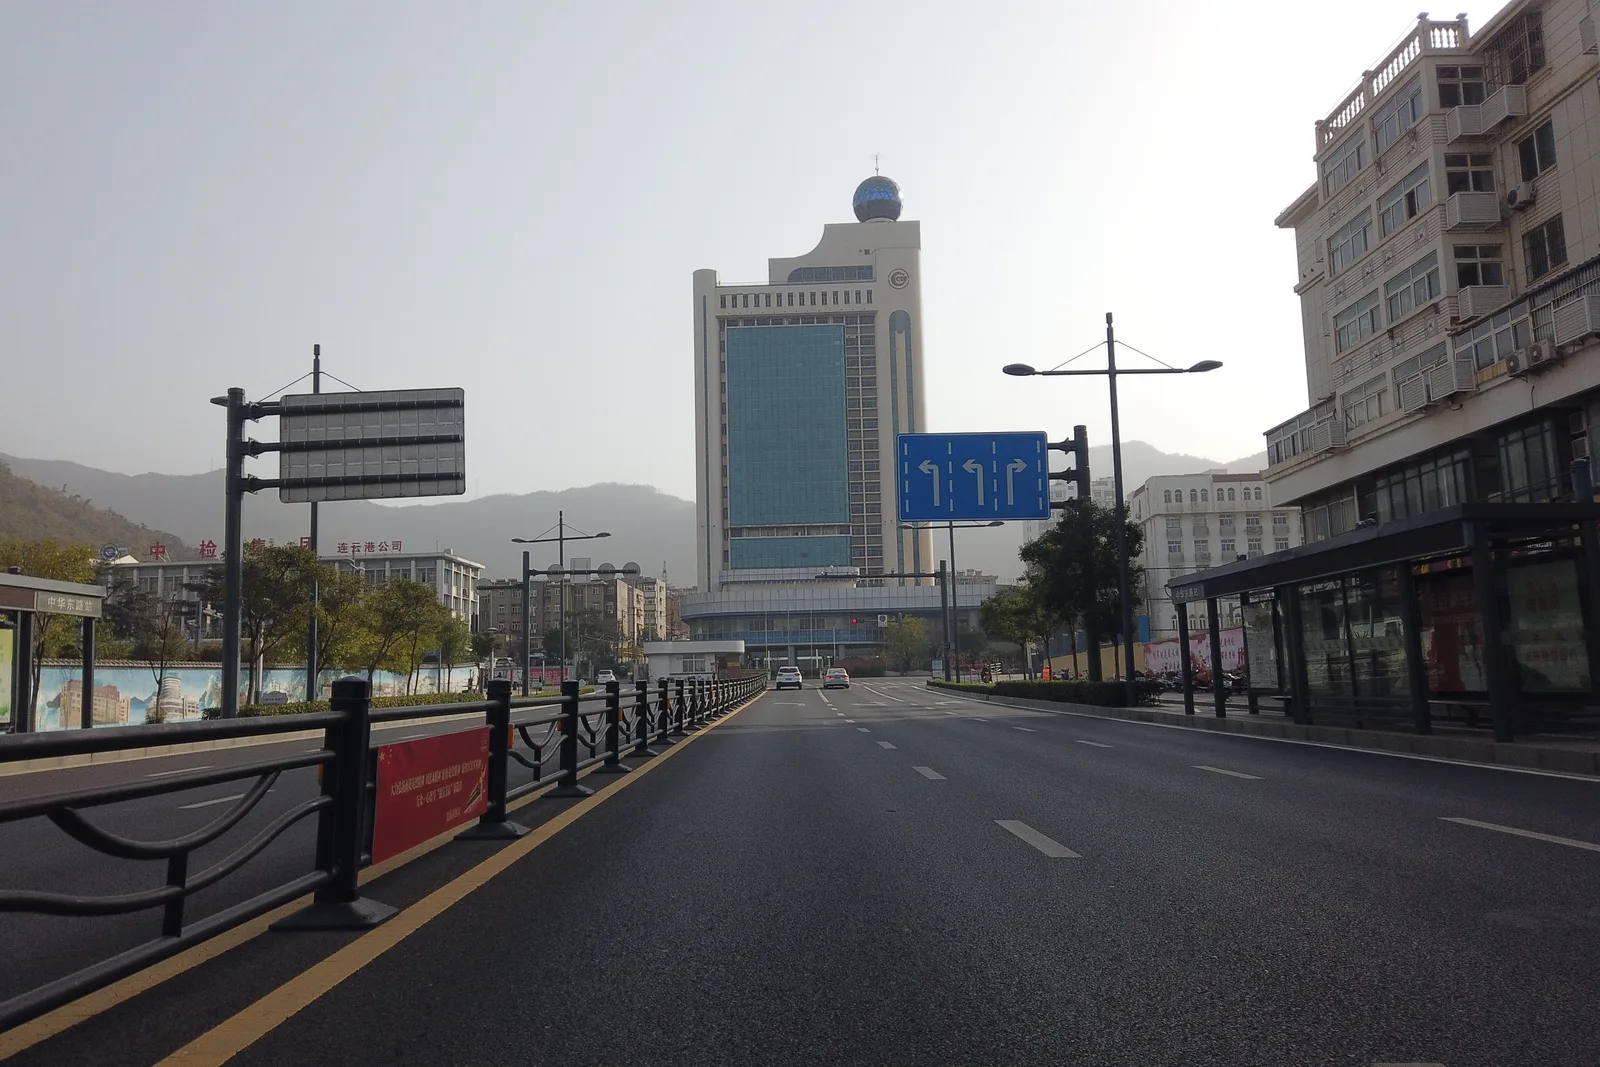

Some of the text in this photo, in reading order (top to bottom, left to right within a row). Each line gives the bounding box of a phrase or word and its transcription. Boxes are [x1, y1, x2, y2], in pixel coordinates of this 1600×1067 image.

[337, 540, 402, 554] 连云港公司
[47, 595, 93, 612] 中华东路站
